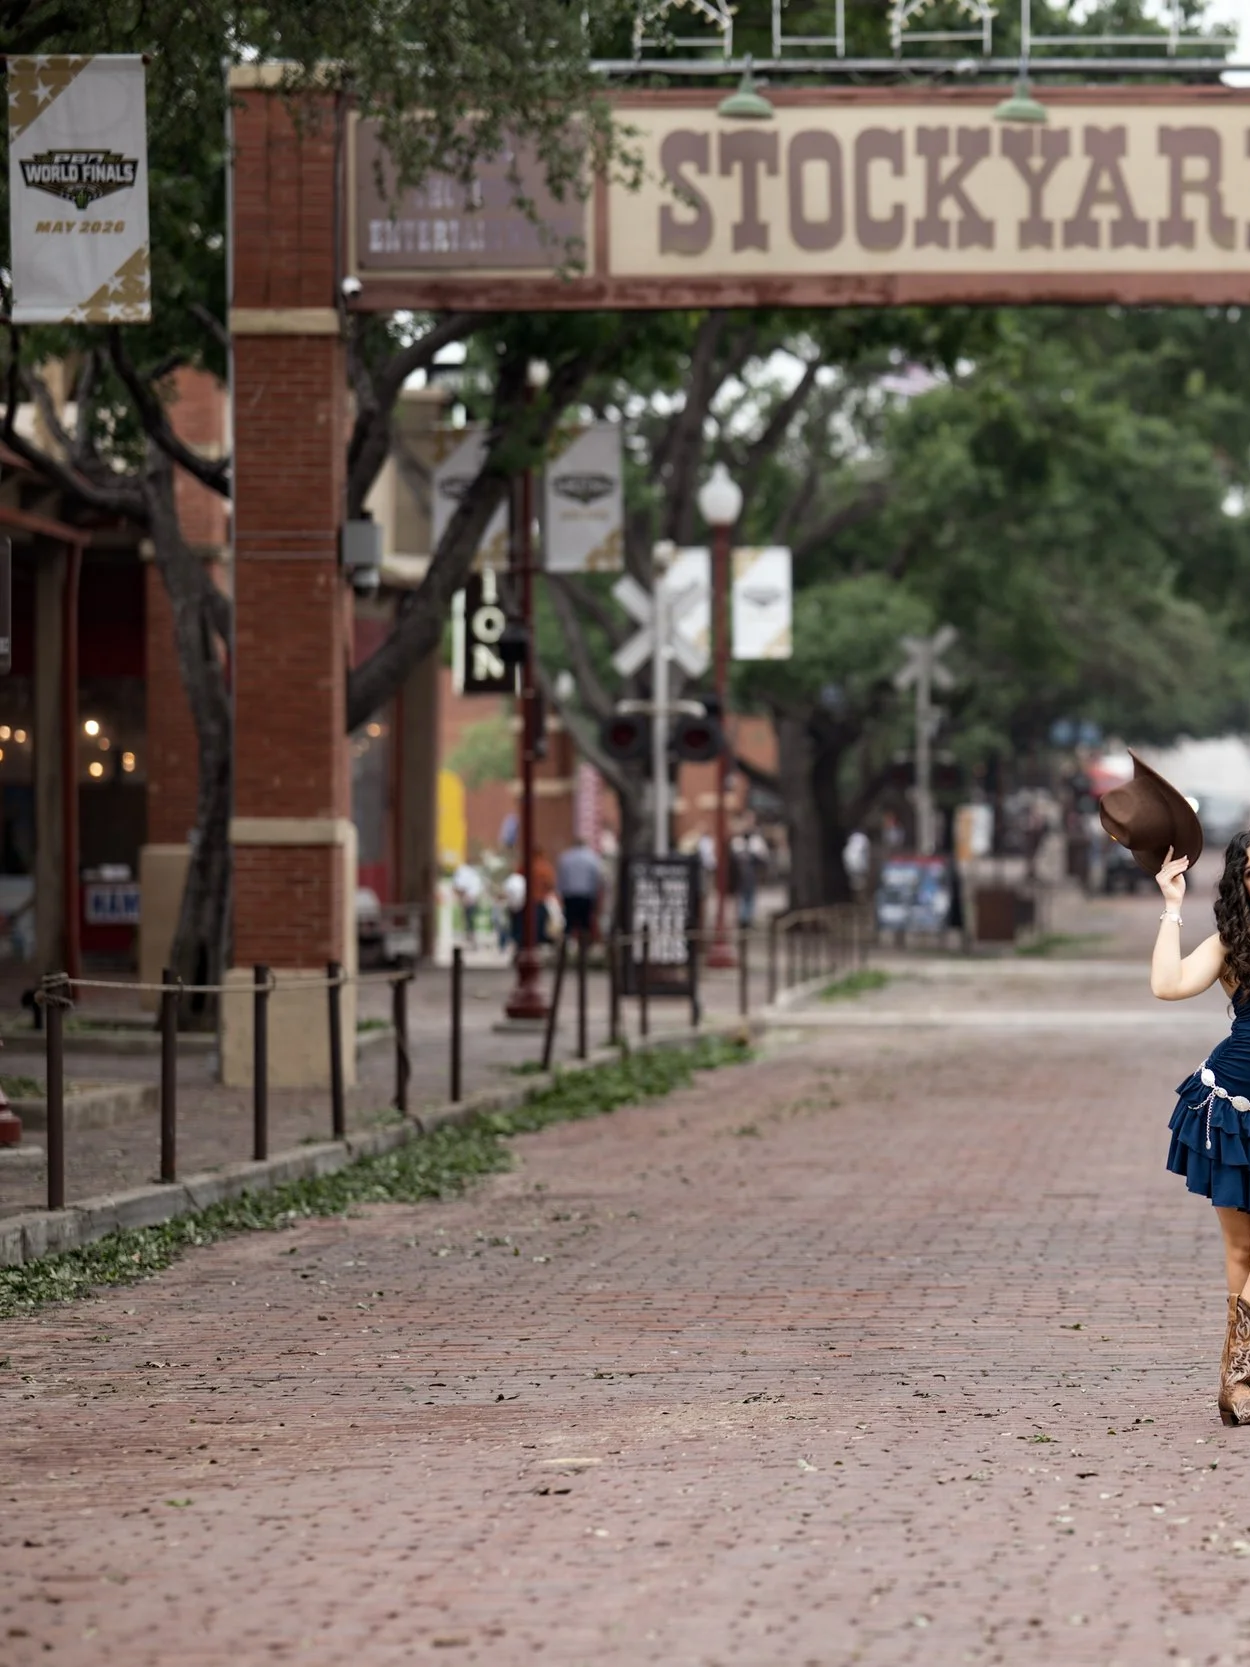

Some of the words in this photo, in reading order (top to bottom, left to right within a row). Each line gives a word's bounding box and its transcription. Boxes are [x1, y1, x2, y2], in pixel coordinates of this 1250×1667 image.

[25, 163, 79, 183] WORLD
[82, 163, 134, 182] FINALS
[35, 220, 76, 234] MAY
[79, 220, 126, 234] 2026
